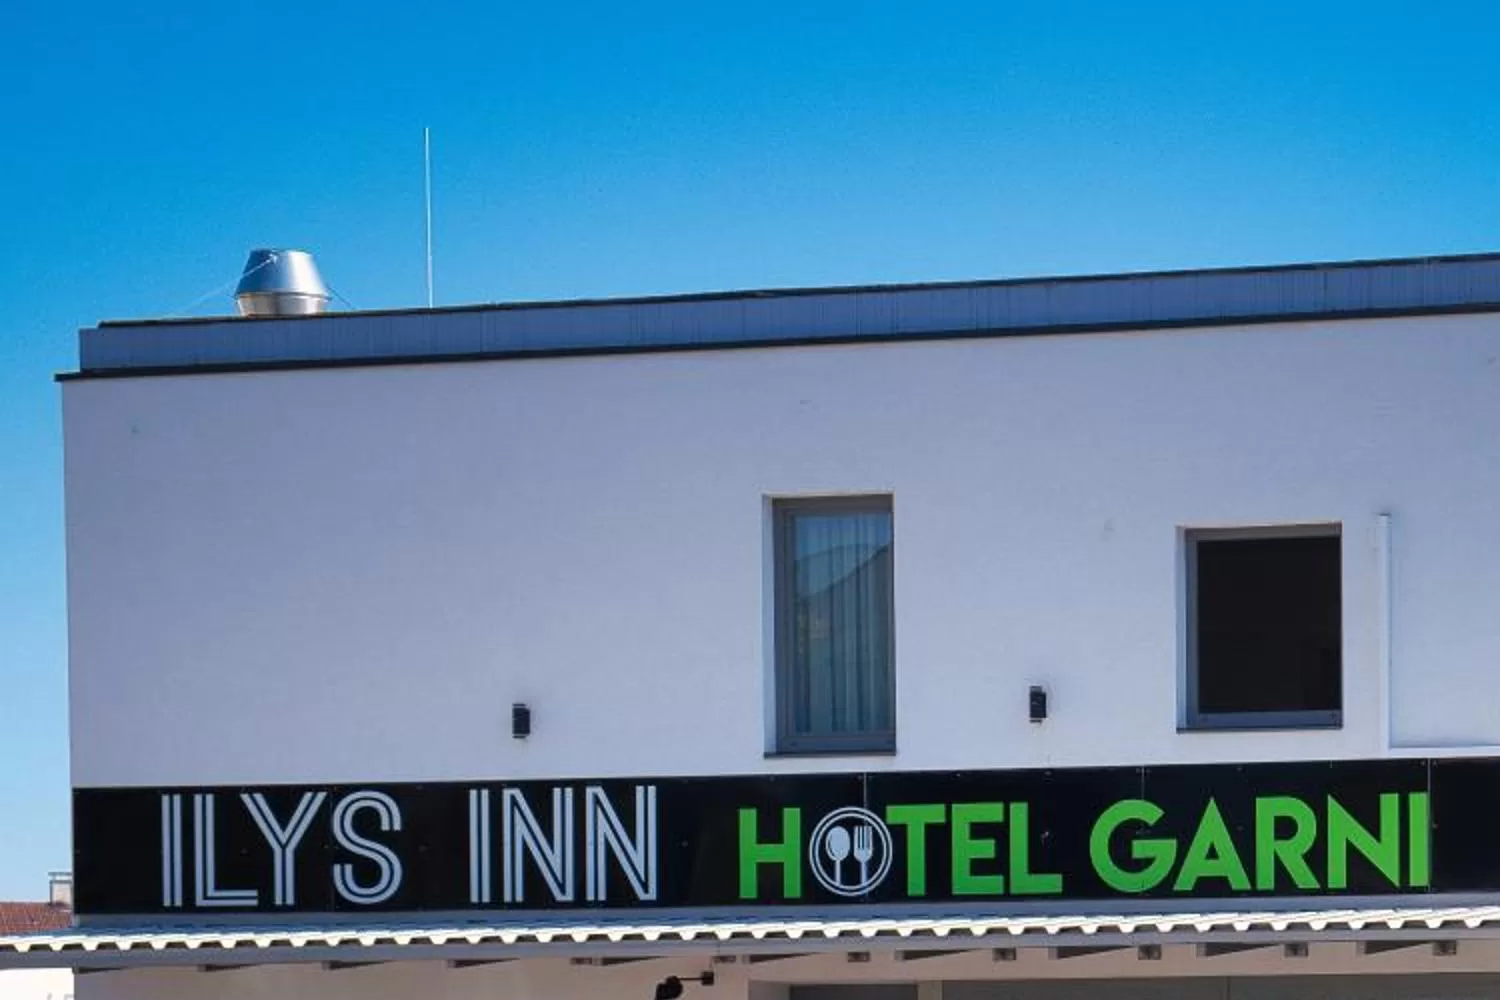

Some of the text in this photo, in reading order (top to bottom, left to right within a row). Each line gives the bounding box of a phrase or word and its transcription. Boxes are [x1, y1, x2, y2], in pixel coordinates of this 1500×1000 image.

[161, 785, 657, 907] ILYS INN
[738, 792, 1429, 899] HOTEL GARNI
